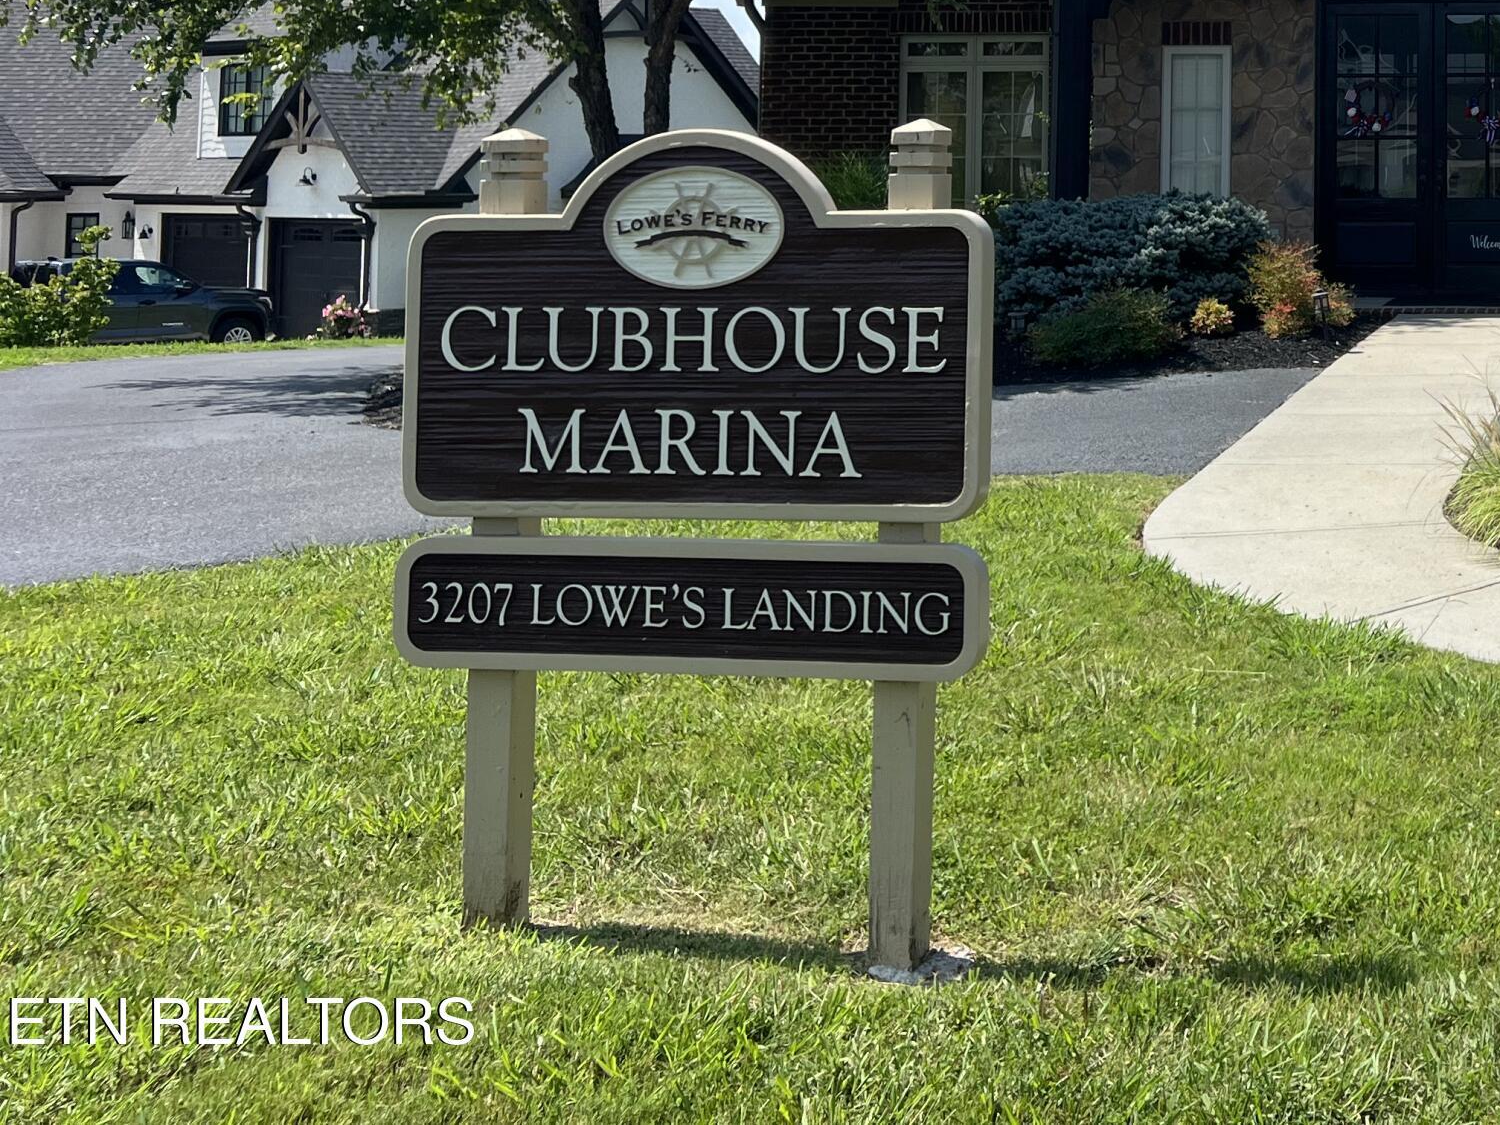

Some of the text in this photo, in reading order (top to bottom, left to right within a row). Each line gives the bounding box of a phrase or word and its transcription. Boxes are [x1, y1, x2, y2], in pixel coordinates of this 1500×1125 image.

[616, 209, 769, 235] LOWE'S FERRY
[441, 306, 948, 374] CLUBHOUSE
[518, 408, 862, 479] MARINA
[418, 581, 952, 636] 3207 LOWE'S LANDING
